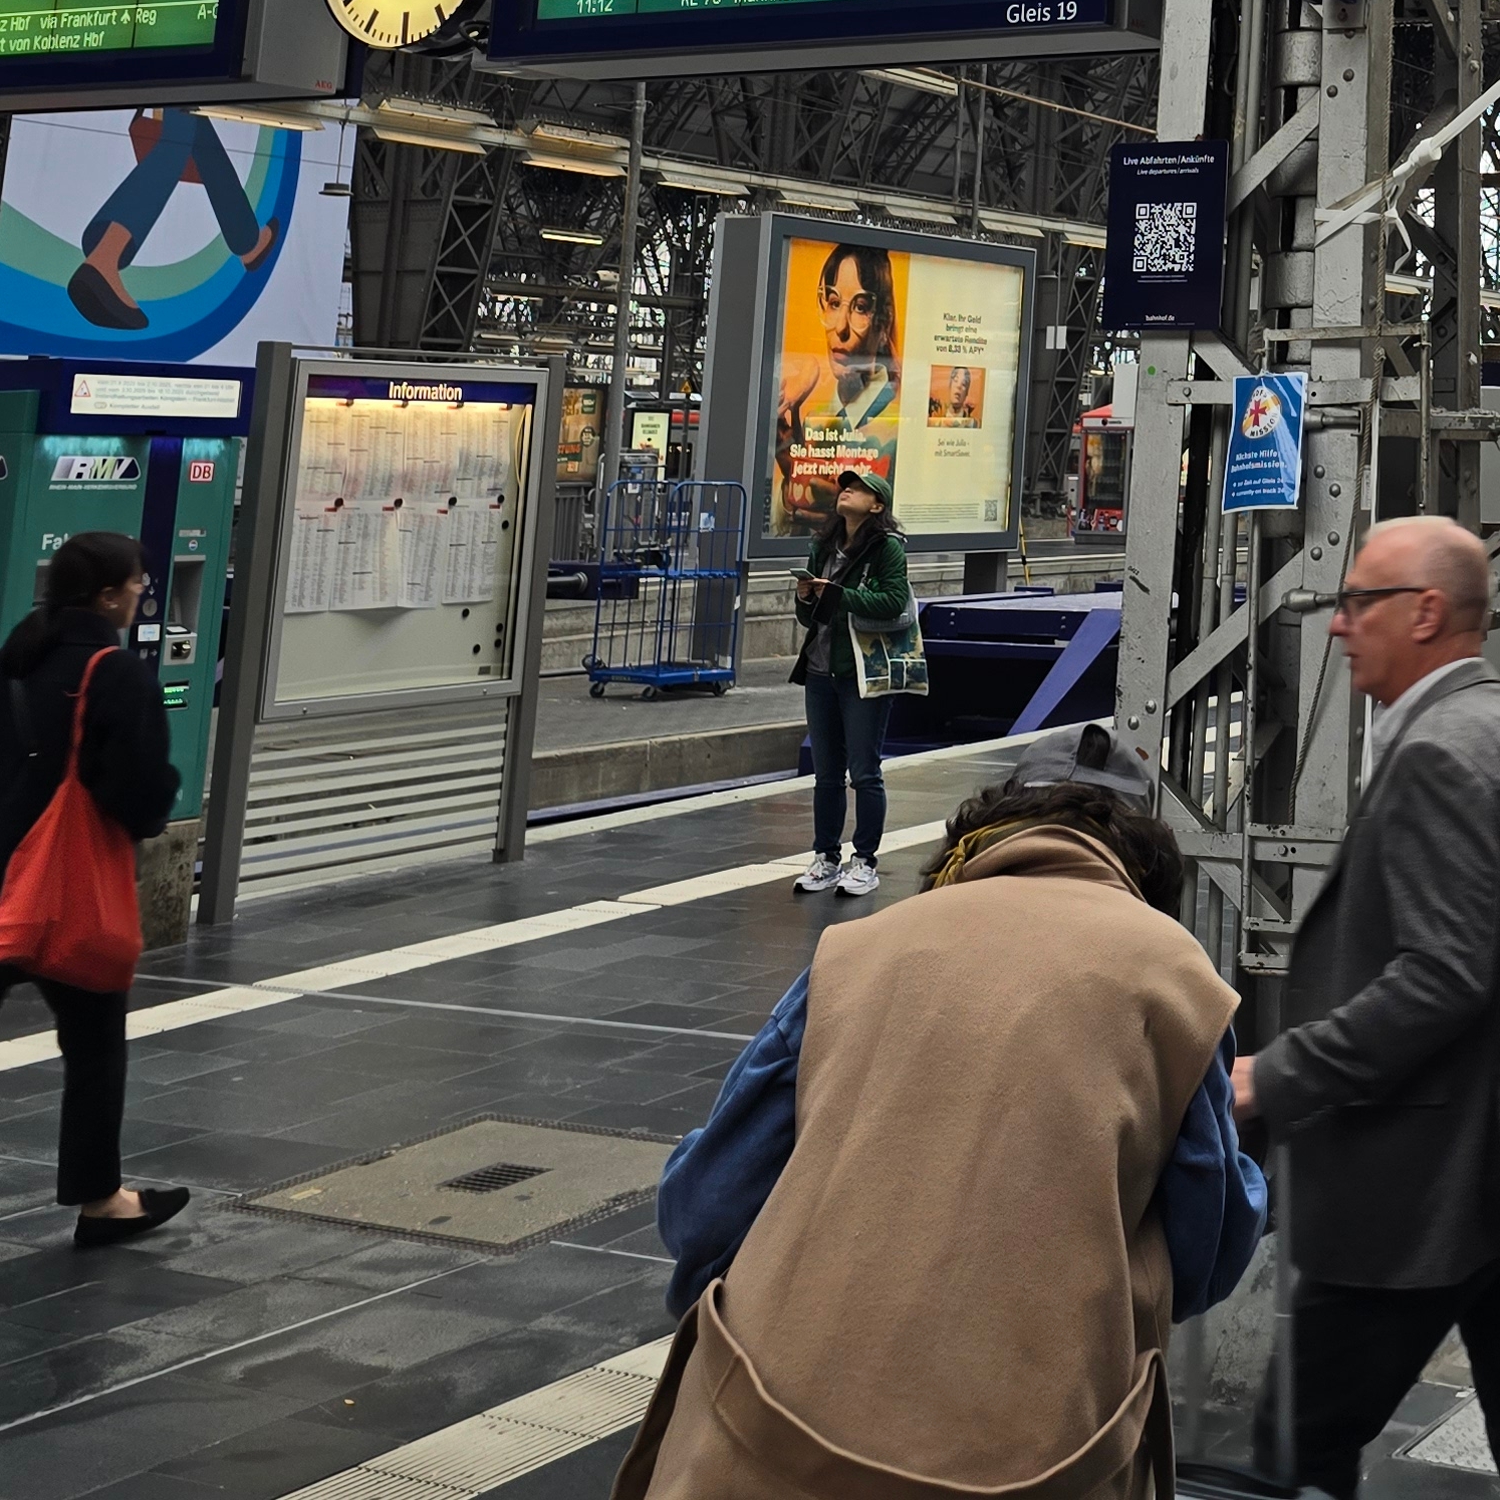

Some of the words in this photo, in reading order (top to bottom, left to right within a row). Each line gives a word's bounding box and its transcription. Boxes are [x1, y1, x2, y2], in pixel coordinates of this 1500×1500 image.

[10, 15, 30, 31] Hbf
[40, 14, 57, 30] via
[60, 9, 117, 28] Frankfurt
[135, 8, 158, 26] Reg
[1006, 2, 1050, 24] Gleis
[1056, 1, 1078, 21] 19
[9, 37, 30, 52] von
[33, 32, 80, 51] Koblenz
[84, 30, 105, 48] Hbf
[1123, 156, 1138, 166] Live
[1140, 154, 1215, 165] Abfahrten/Ankünfte
[389, 380, 463, 401] Information
[805, 427, 824, 442] Das
[825, 427, 838, 442] ist
[839, 428, 866, 442] Julia.
[790, 443, 807, 458] Sie
[808, 444, 835, 458] hasst
[836, 444, 878, 461] Montage
[66, 456, 136, 481] RMV
[191, 464, 212, 480] DB
[791, 461, 818, 478] jetzt
[818, 461, 844, 475] nicht
